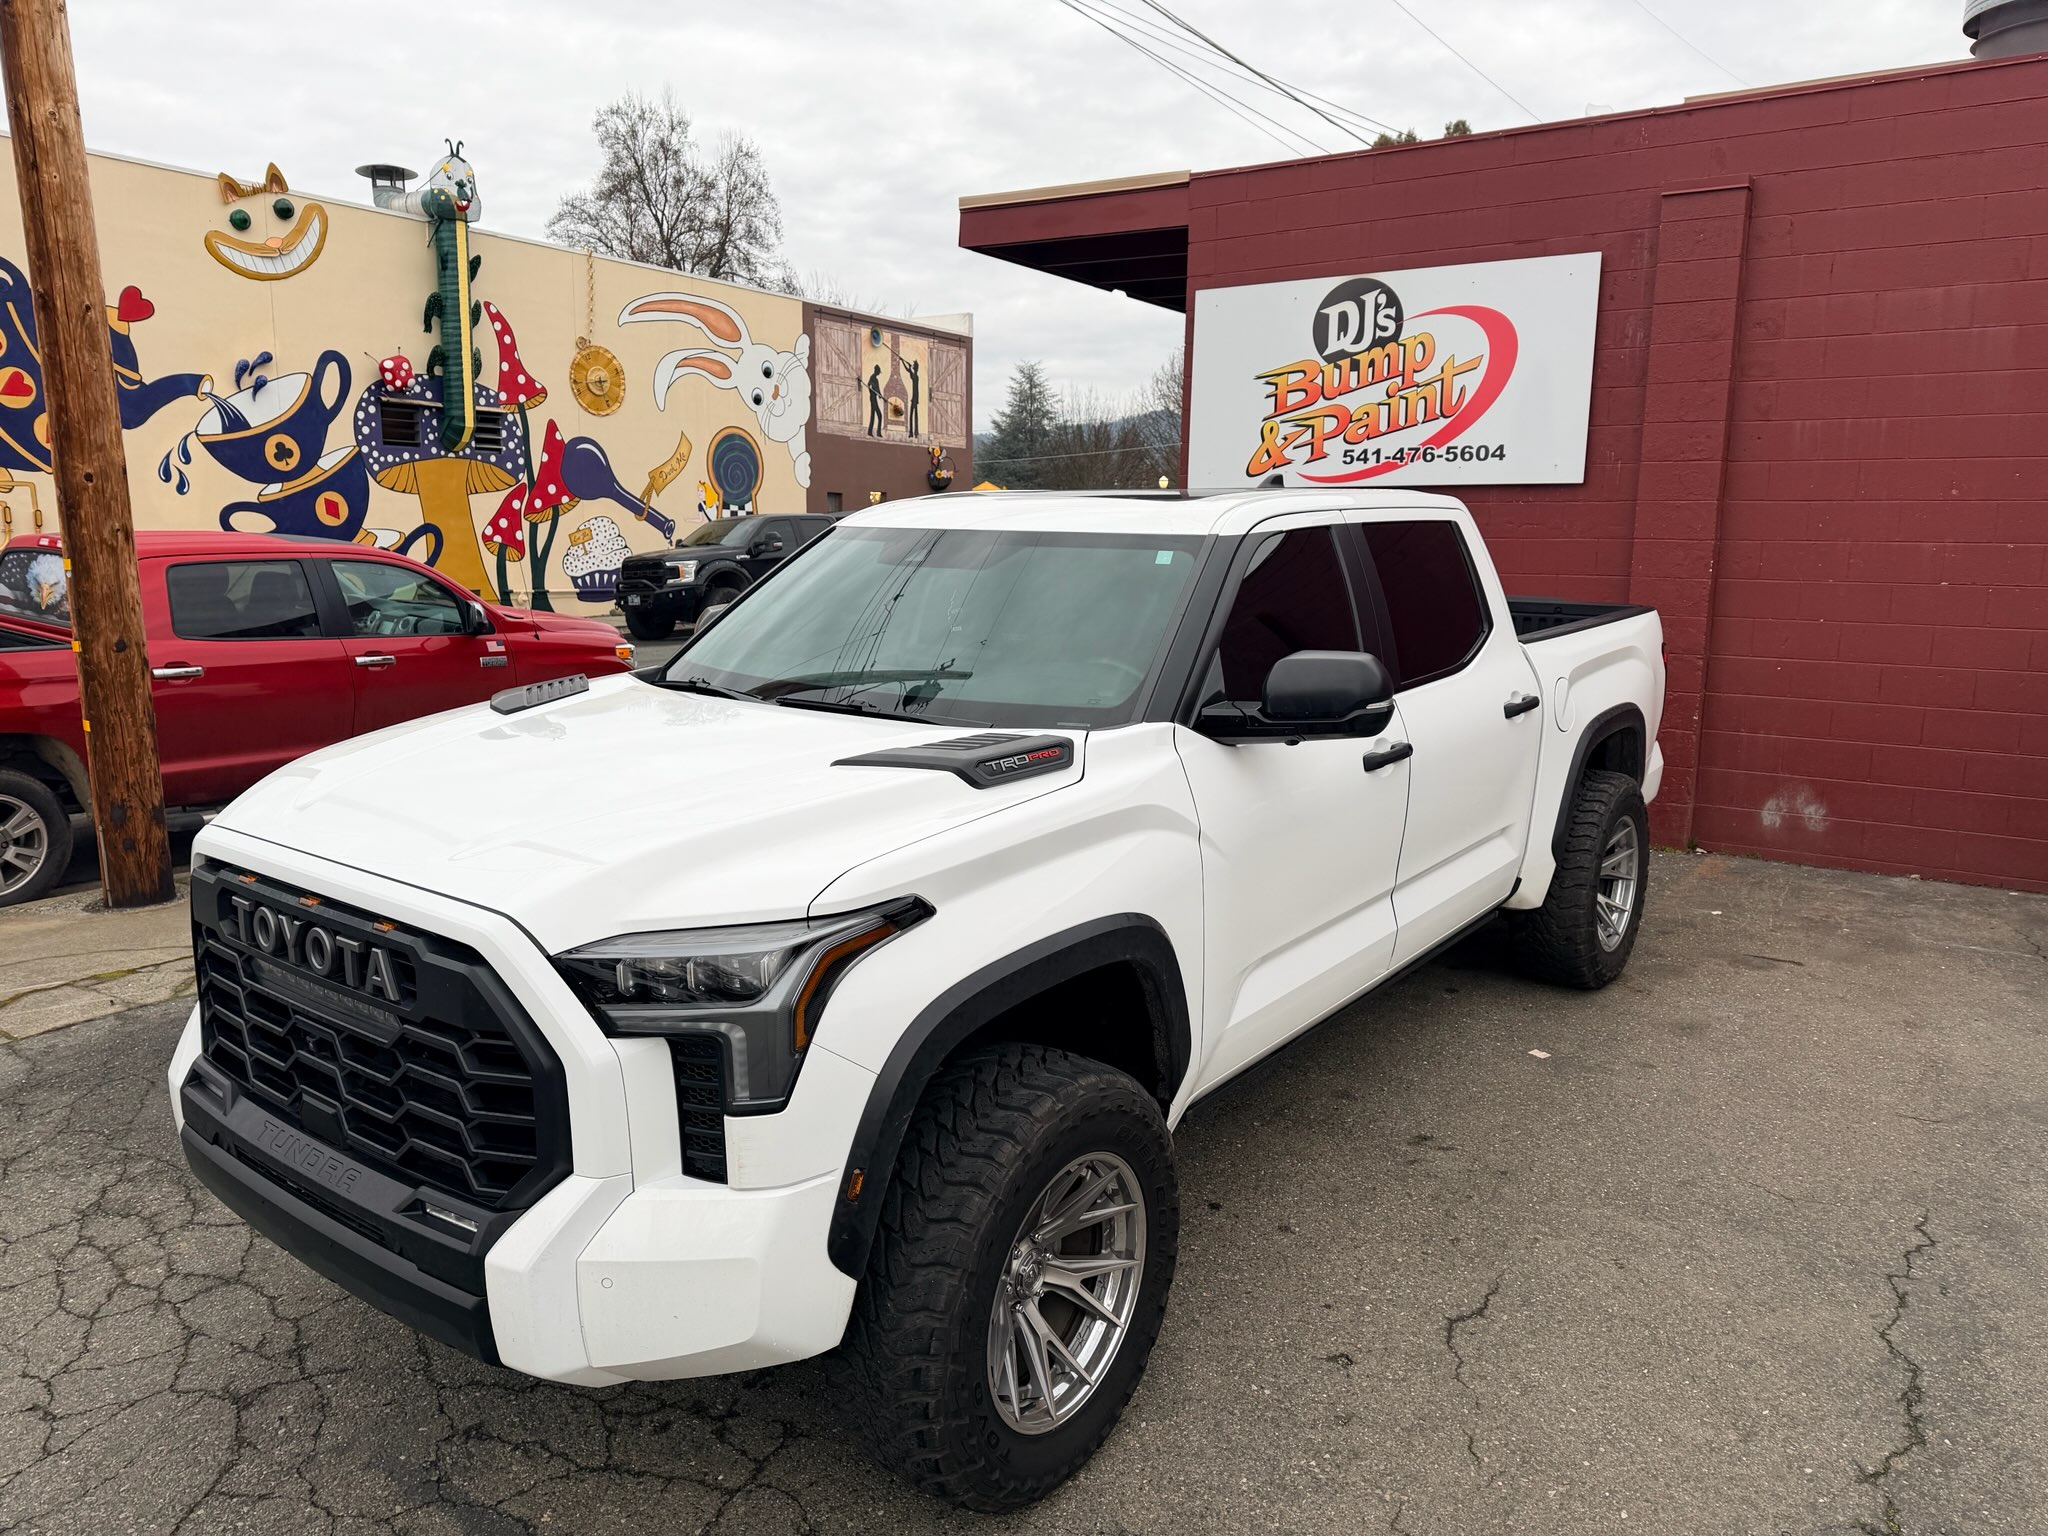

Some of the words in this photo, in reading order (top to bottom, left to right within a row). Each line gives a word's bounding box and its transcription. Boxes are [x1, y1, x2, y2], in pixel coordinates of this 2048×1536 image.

[1320, 288, 1397, 358] DJ's
[1246, 420, 1309, 477] &
[1280, 354, 1484, 465] Paint
[1254, 332, 1436, 421] Bump
[1341, 444, 1506, 466] 541-476-5604
[231, 895, 400, 1001] TOYOTA
[257, 1120, 362, 1194] TUNDRA
